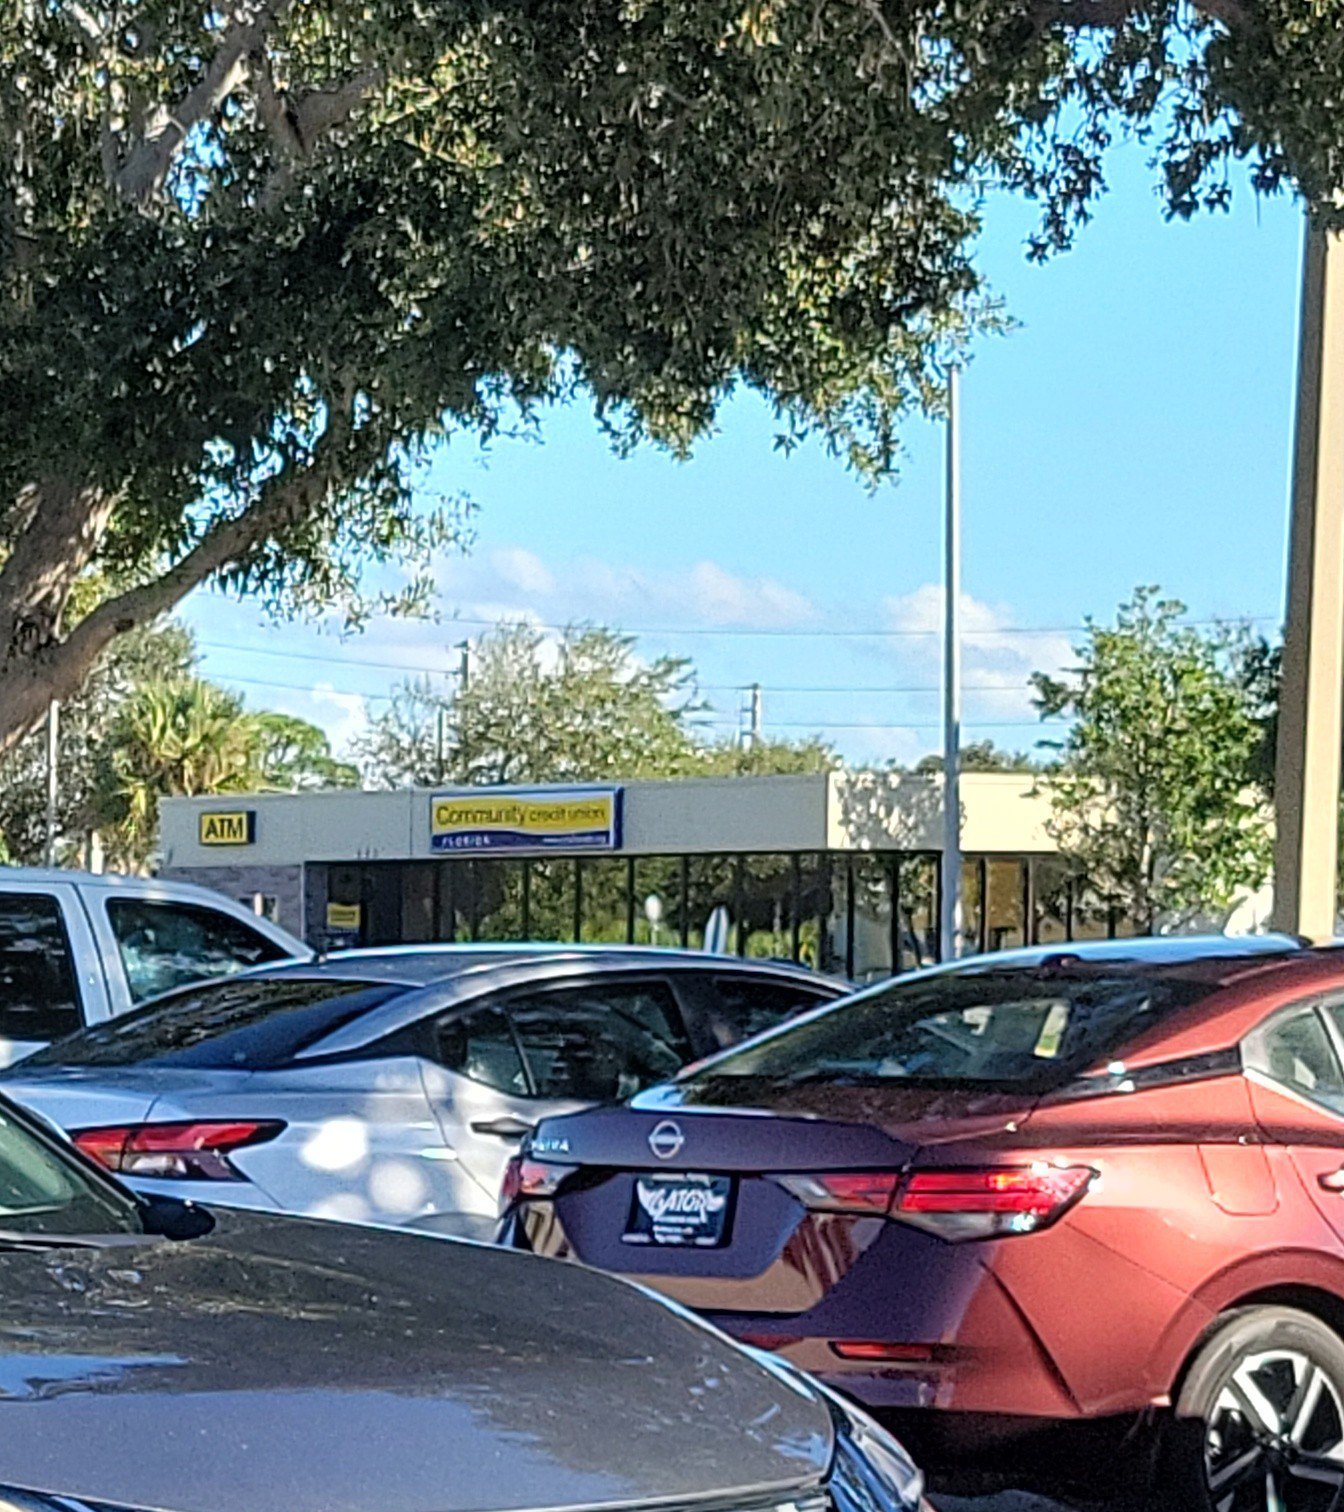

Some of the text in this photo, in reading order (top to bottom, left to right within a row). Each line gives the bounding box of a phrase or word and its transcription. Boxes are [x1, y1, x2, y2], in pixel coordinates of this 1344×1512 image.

[435, 804, 528, 827] Community
[204, 817, 244, 840] ATM
[648, 1187, 708, 1224] GATOR
